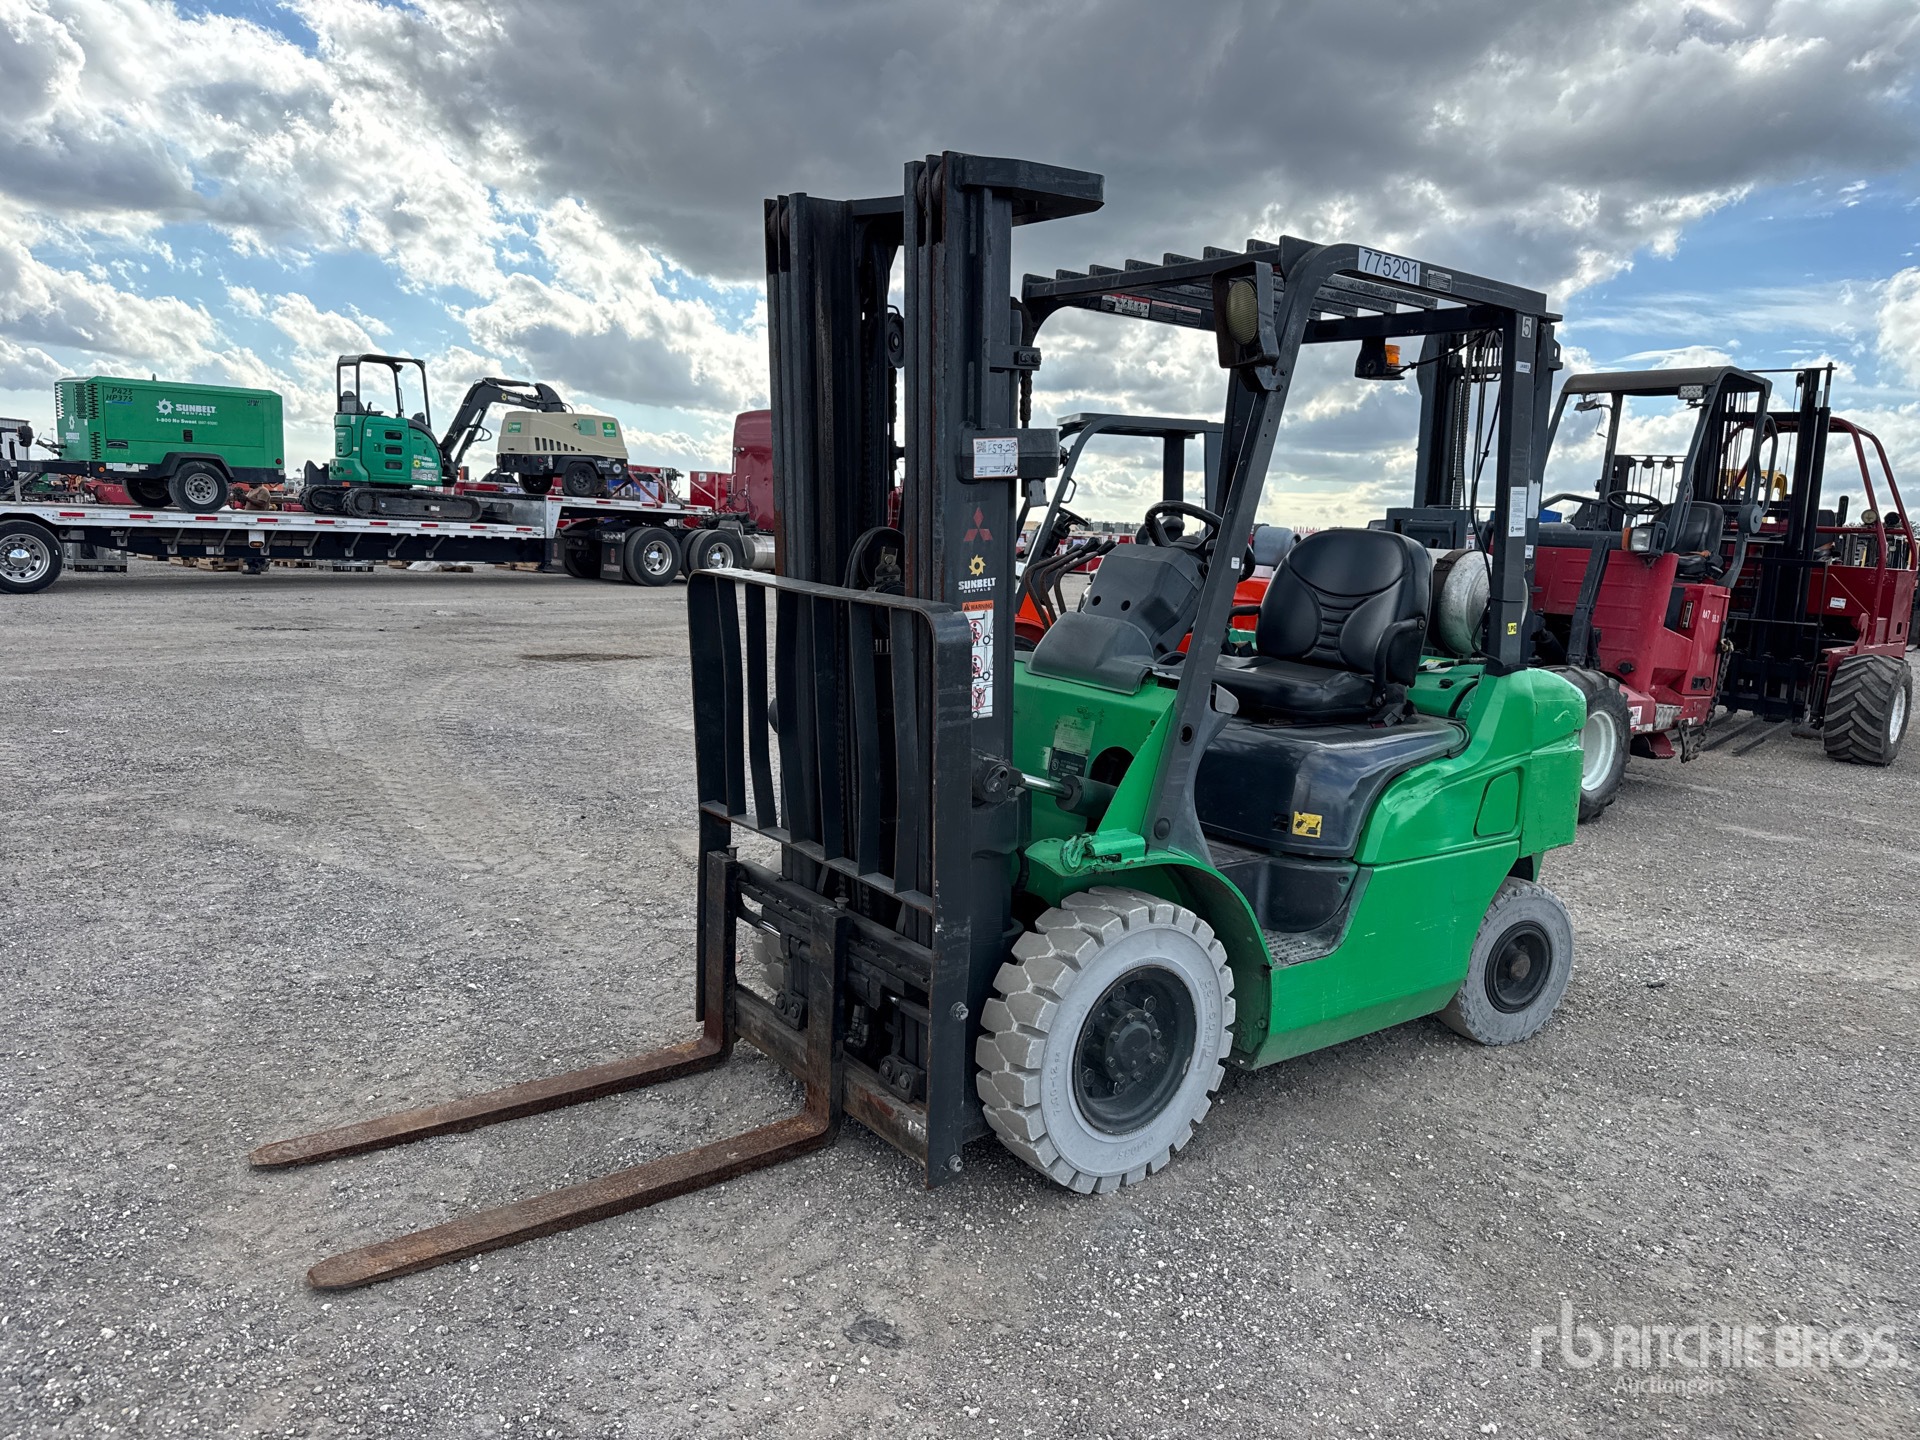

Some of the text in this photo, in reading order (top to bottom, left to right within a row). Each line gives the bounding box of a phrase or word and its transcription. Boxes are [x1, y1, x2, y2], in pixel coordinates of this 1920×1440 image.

[1363, 250, 1417, 284] 775291
[1523, 317, 1531, 337] 5
[112, 386, 133, 396] P425
[105, 394, 133, 402] HP375
[175, 403, 217, 414] SUNBELT
[958, 577, 996, 590] SUNBELT
[970, 602, 993, 610] WARNING
